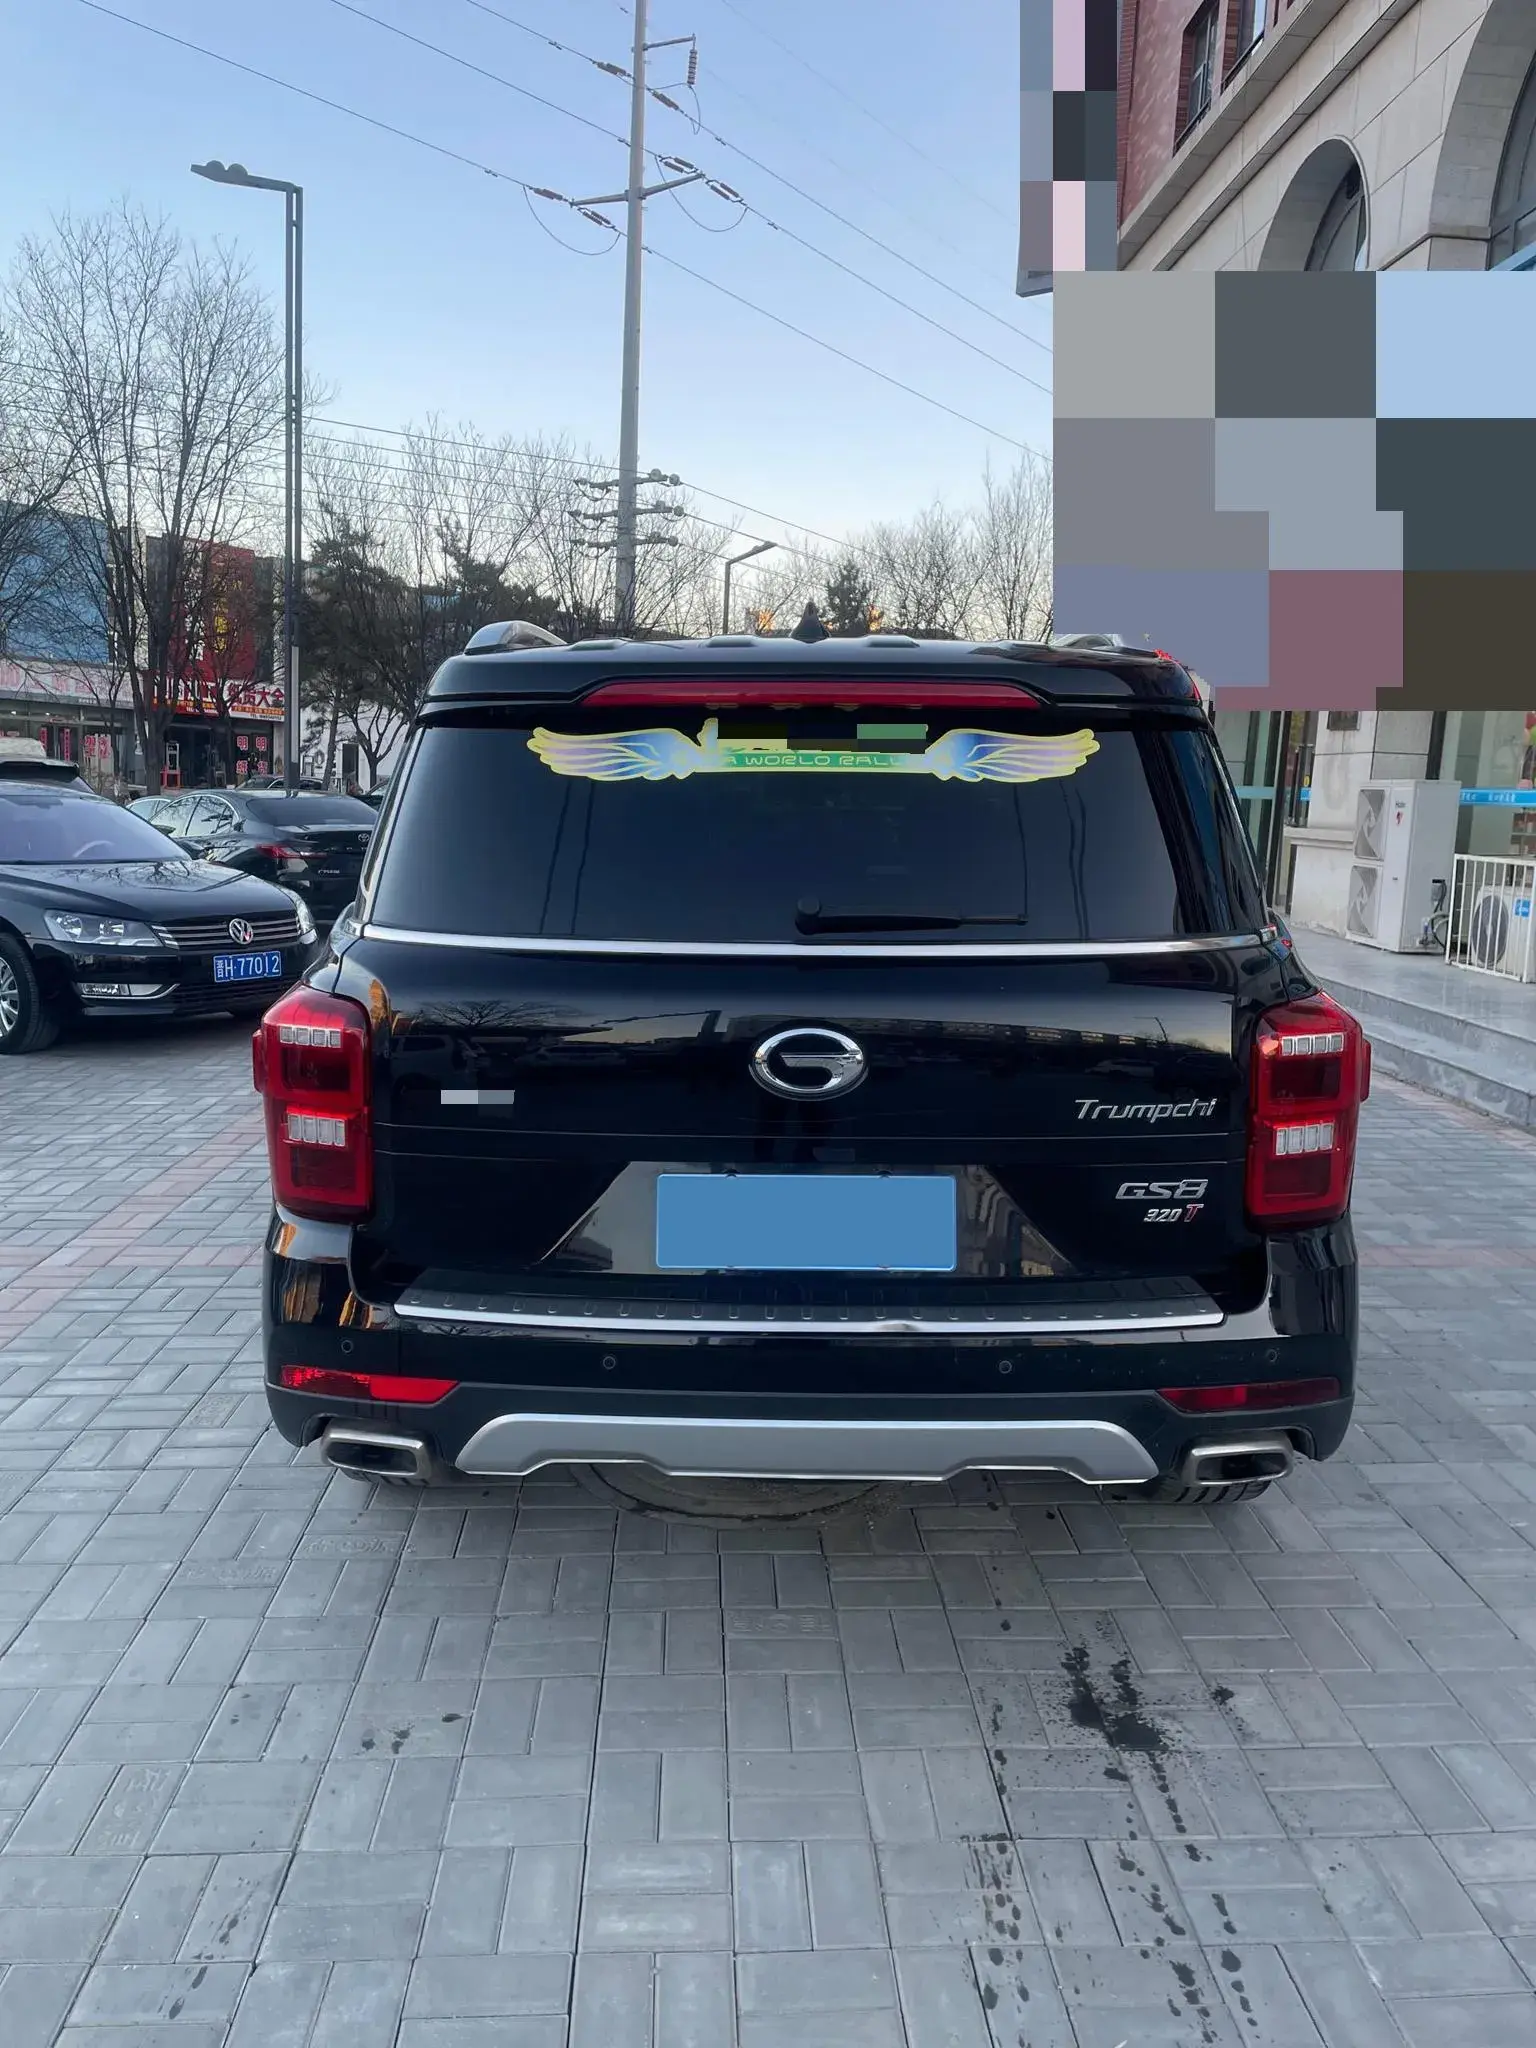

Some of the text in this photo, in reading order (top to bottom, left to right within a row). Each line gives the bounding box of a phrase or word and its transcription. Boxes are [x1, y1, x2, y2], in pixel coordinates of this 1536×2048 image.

[745, 755, 830, 766] WORLD
[1074, 1098, 1218, 1123] Trumpchi
[1115, 1178, 1208, 1199] GS8
